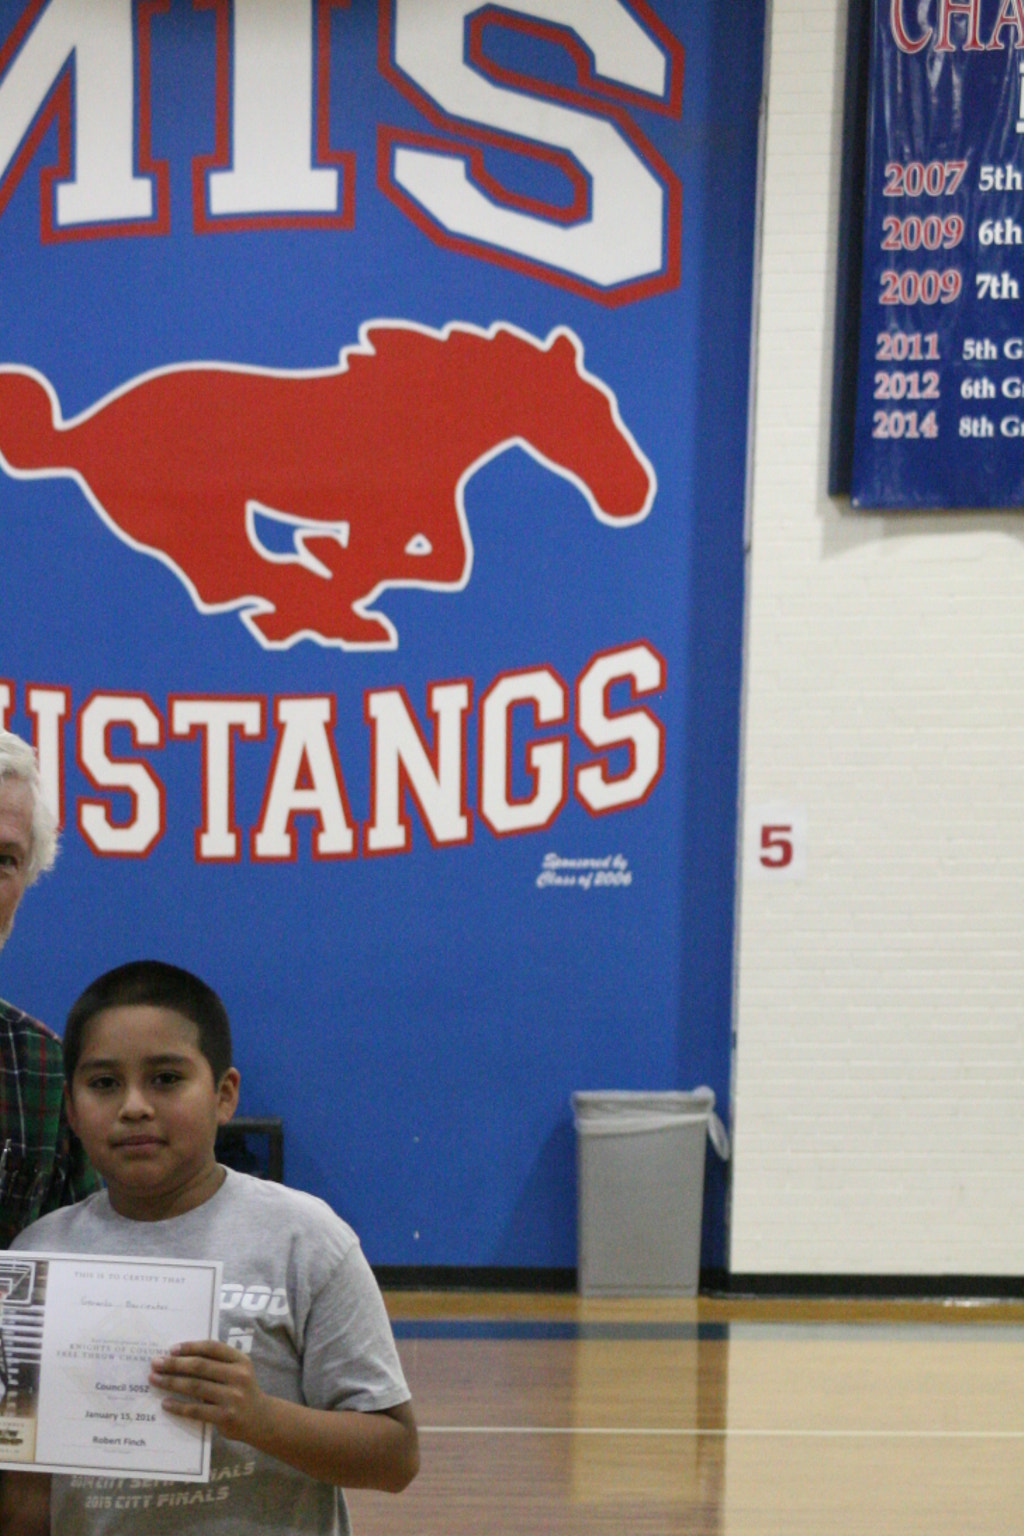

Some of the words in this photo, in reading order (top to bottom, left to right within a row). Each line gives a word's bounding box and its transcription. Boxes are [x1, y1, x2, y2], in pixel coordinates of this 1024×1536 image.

[882, 160, 968, 197] 2007
[978, 164, 1023, 191] 5th
[880, 214, 965, 251] 2009
[978, 218, 1023, 246] 6th
[878, 268, 962, 305] 2009
[975, 271, 1020, 300] 7th
[875, 331, 941, 361] 2011
[962, 337, 997, 360] 5th
[873, 369, 940, 400] 2012
[960, 376, 995, 399] 6th
[871, 409, 939, 439] 2014
[958, 415, 994, 438] 8th
[759, 824, 794, 869] 5
[95, 1382, 127, 1392] Council
[85, 1410, 118, 1422] January
[135, 1412, 157, 1422] 2016
[92, 1435, 122, 1446] Robert
[123, 1437, 147, 1447] Finch
[156, 1486, 230, 1508] FINALS
